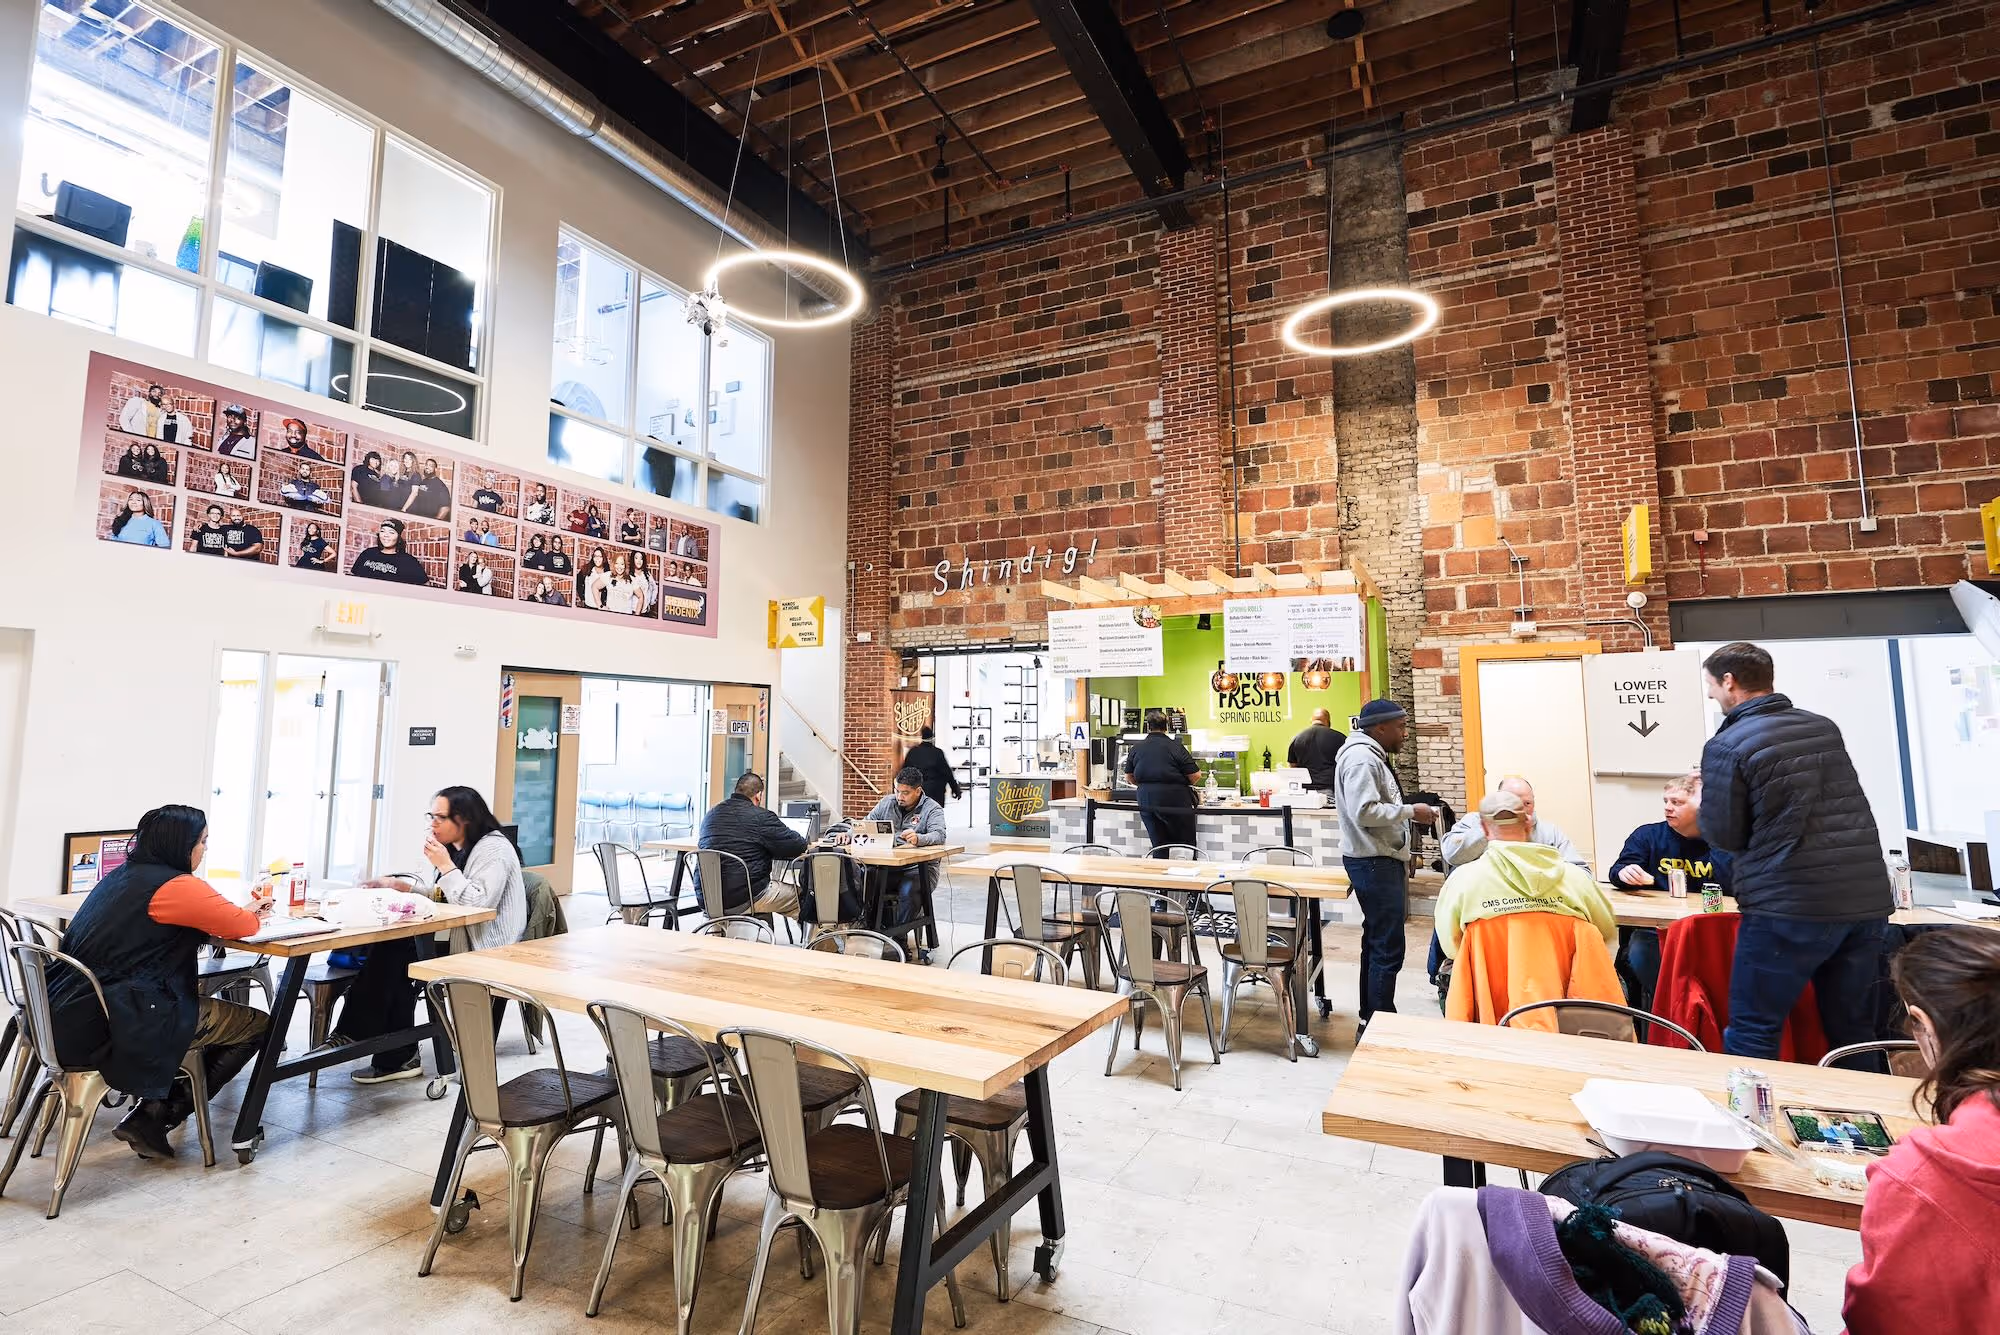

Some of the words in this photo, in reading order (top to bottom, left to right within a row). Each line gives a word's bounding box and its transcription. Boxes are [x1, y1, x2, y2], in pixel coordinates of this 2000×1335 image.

[933, 538, 1098, 596] Shindig!
[336, 603, 369, 625] EXIT
[664, 604, 699, 619] PHOENIX
[1614, 680, 1668, 691] LOWER
[1219, 683, 1281, 710] FRESH
[1619, 694, 1665, 705] LEVEL
[894, 695, 928, 721] Shindig!
[1220, 711, 1251, 723] SPRING
[1253, 711, 1281, 722] ROLLS
[732, 722, 750, 733] OPEN
[1074, 726, 1085, 740] A
[996, 780, 1045, 802] Shindig!
[1000, 801, 1033, 820] COFFEE
[1658, 857, 1713, 879] SPAM
[1482, 899, 1501, 909] CMS
[1493, 905, 1523, 913] Carpenter
